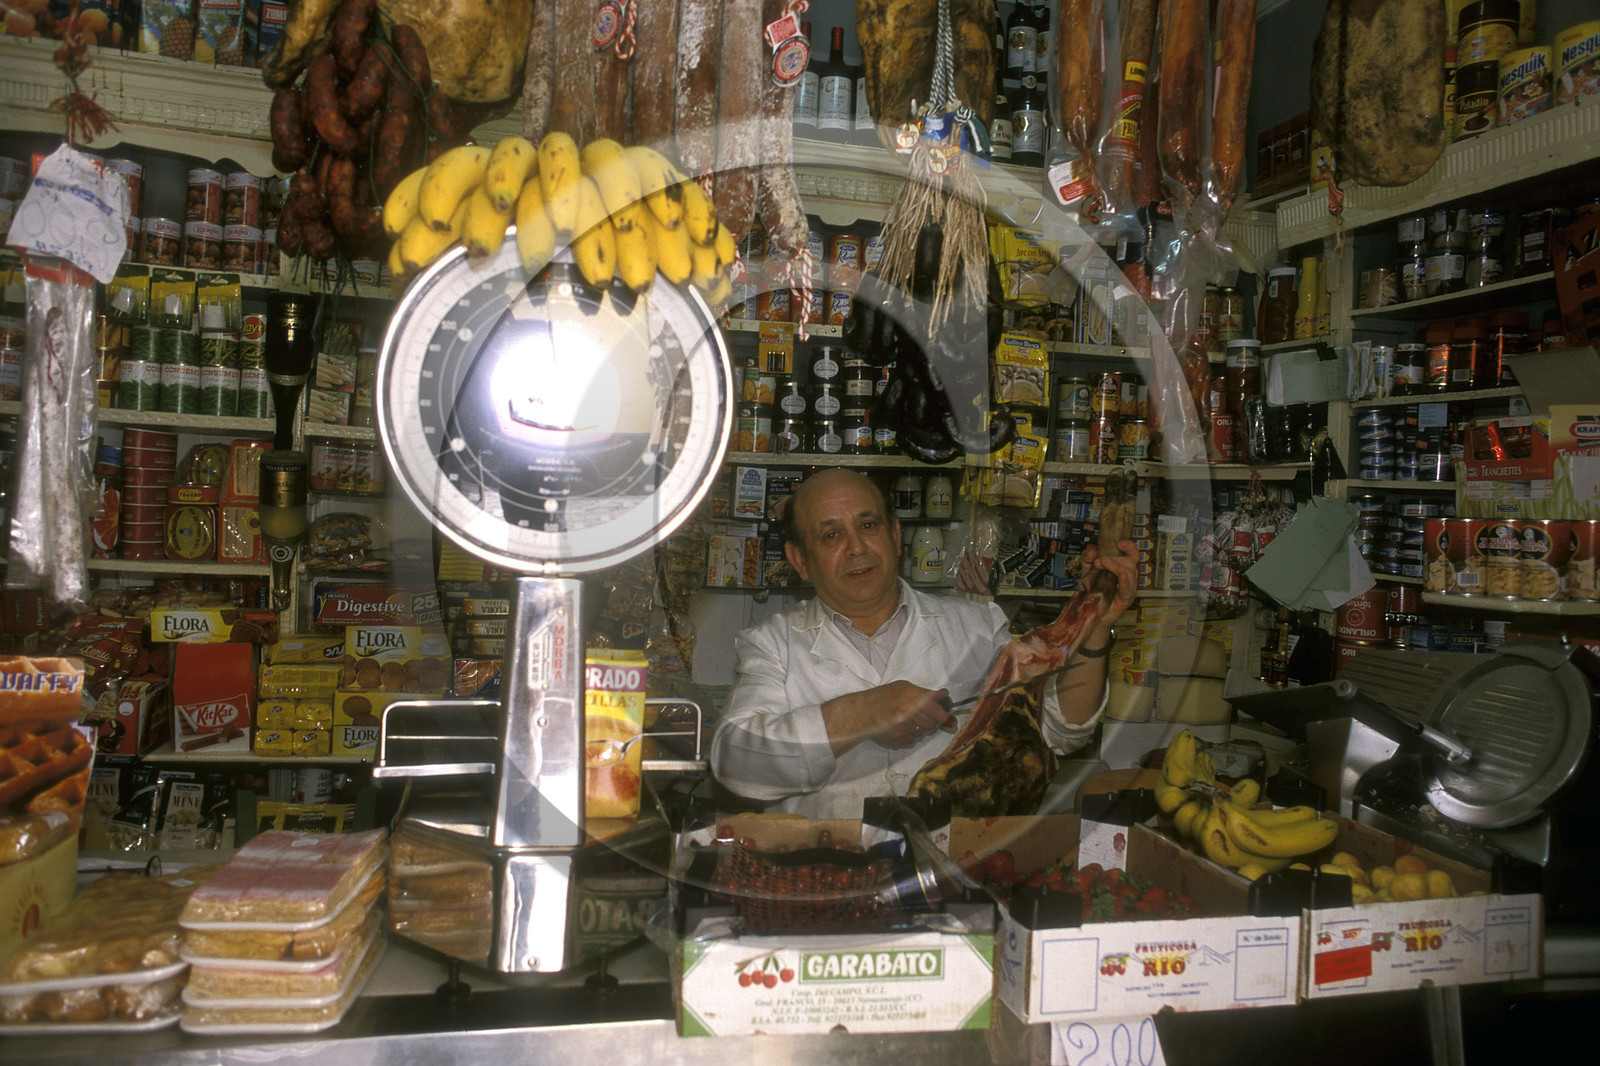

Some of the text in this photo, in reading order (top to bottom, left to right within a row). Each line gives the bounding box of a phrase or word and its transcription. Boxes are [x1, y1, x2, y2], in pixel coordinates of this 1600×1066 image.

[336, 600, 405, 616] Digestive
[163, 616, 209, 632] FLORA
[1337, 626, 1377, 637] ORLANDO
[356, 630, 407, 648] FLORA
[196, 703, 235, 727] KitKat
[1405, 935, 1443, 953] RIO
[806, 952, 938, 978] GARABATO
[1142, 957, 1186, 977] RIO
